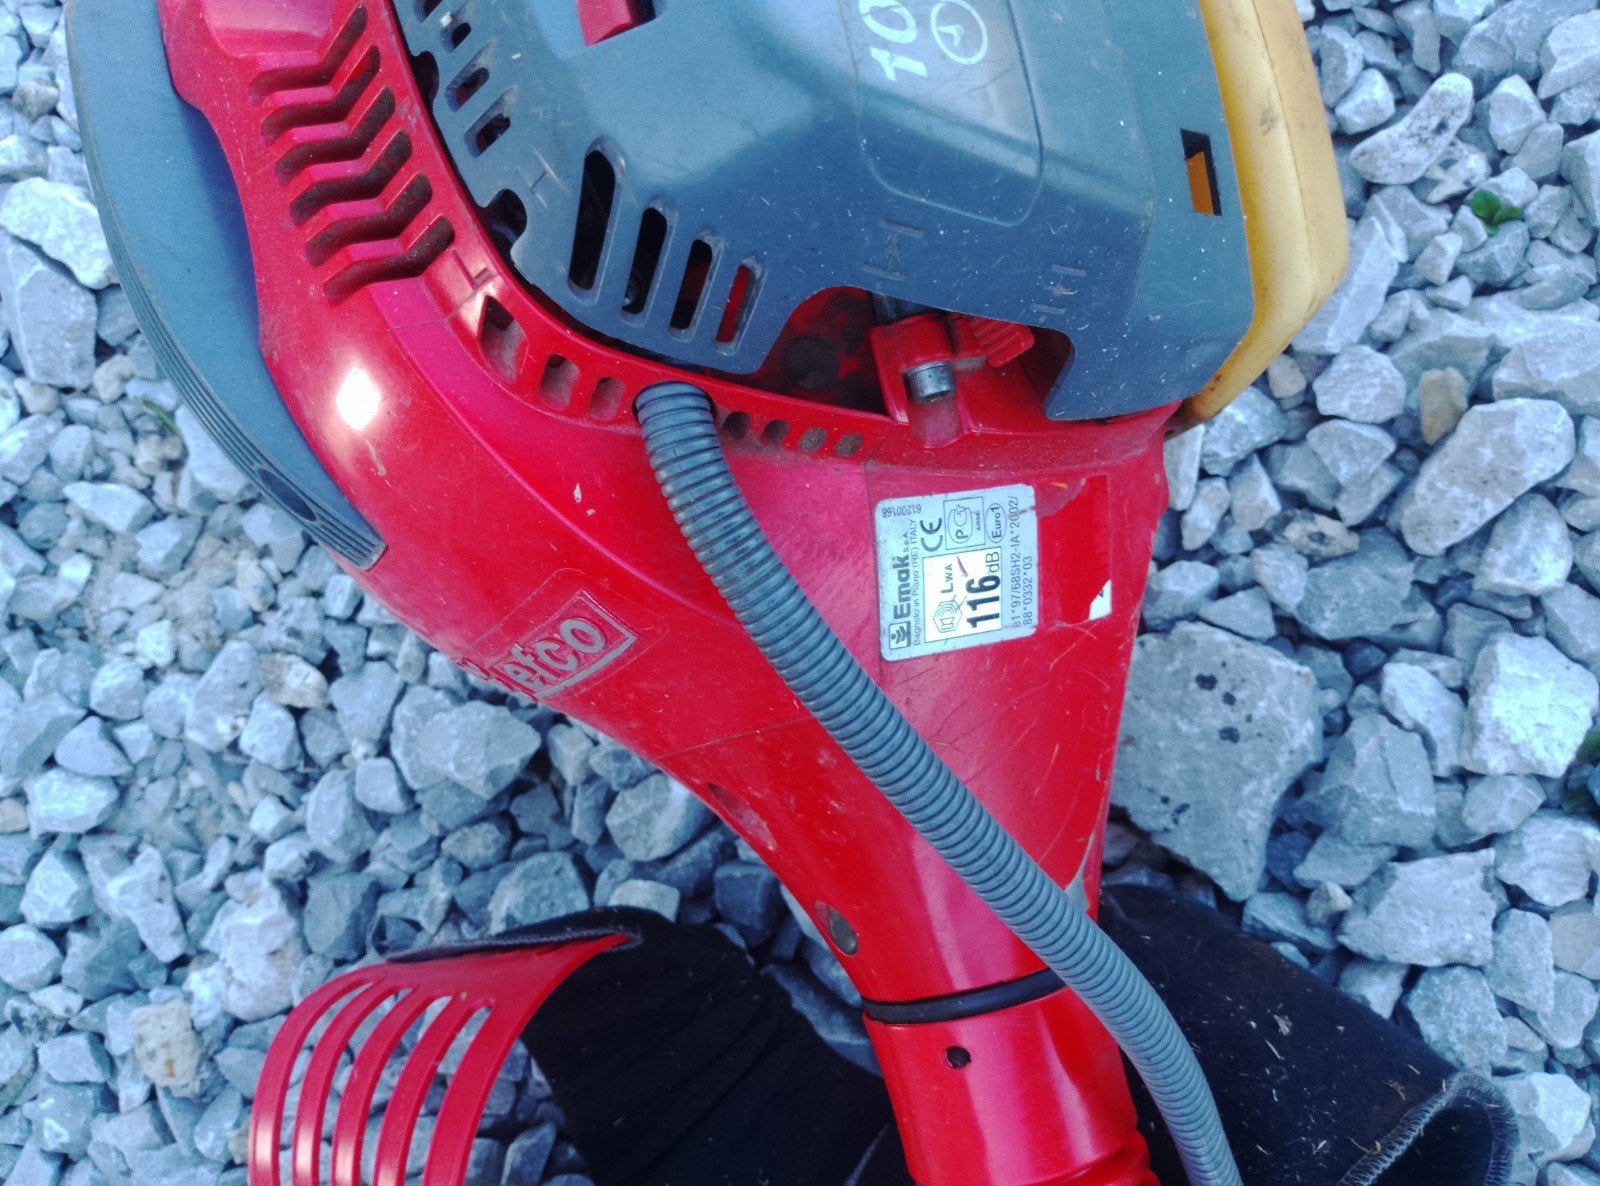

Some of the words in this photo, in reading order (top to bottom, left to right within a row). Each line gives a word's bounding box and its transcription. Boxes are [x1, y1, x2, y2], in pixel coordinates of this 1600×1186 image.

[858, 0, 928, 82] 10
[909, 519, 918, 544] ITALY
[920, 518, 944, 552] CE
[892, 554, 911, 619] Emak
[965, 575, 1000, 628] 116
